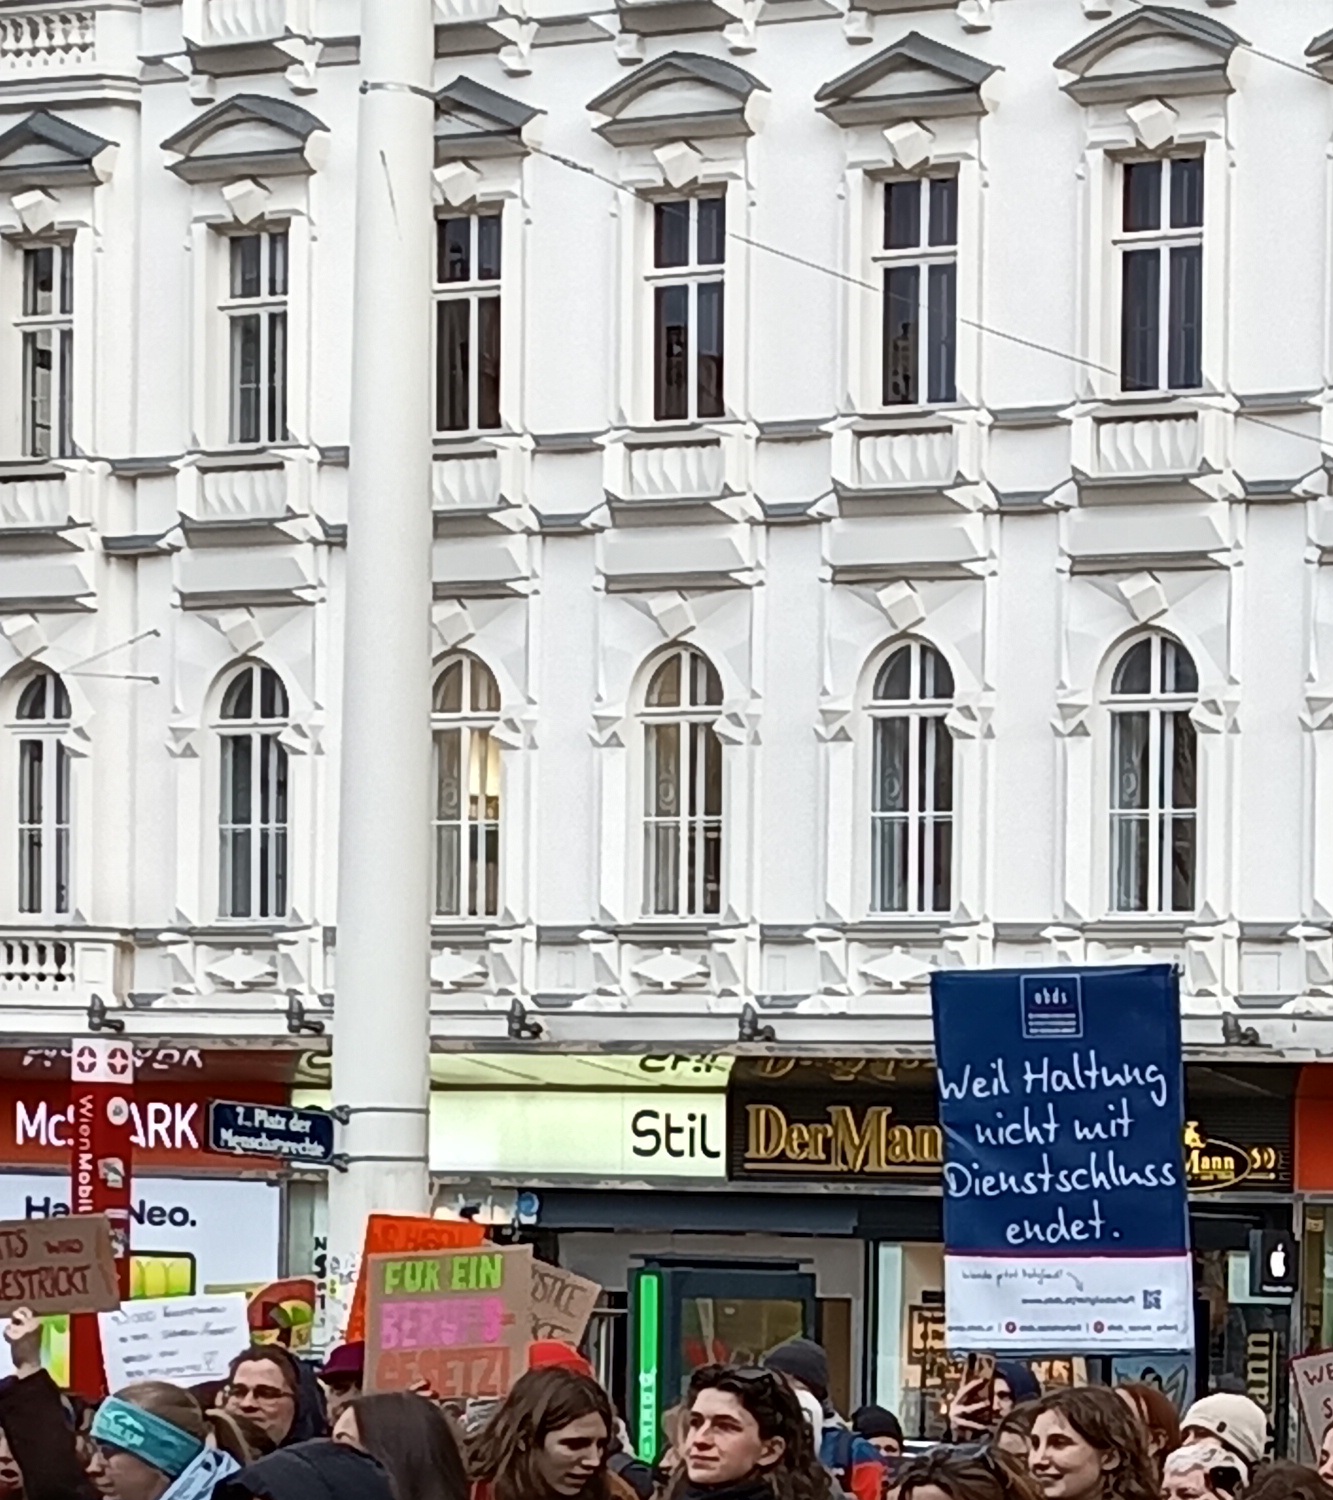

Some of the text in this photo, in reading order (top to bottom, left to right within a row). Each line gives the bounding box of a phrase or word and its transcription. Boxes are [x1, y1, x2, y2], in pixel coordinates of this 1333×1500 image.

[938, 1049, 1168, 1107] Weil Haltung
[631, 1109, 721, 1159] Stil
[975, 1097, 1135, 1145] nicht mit
[943, 1150, 1177, 1198] Dienstschluss
[1006, 1199, 1120, 1244] endet.
[450, 1253, 503, 1291] EIN
